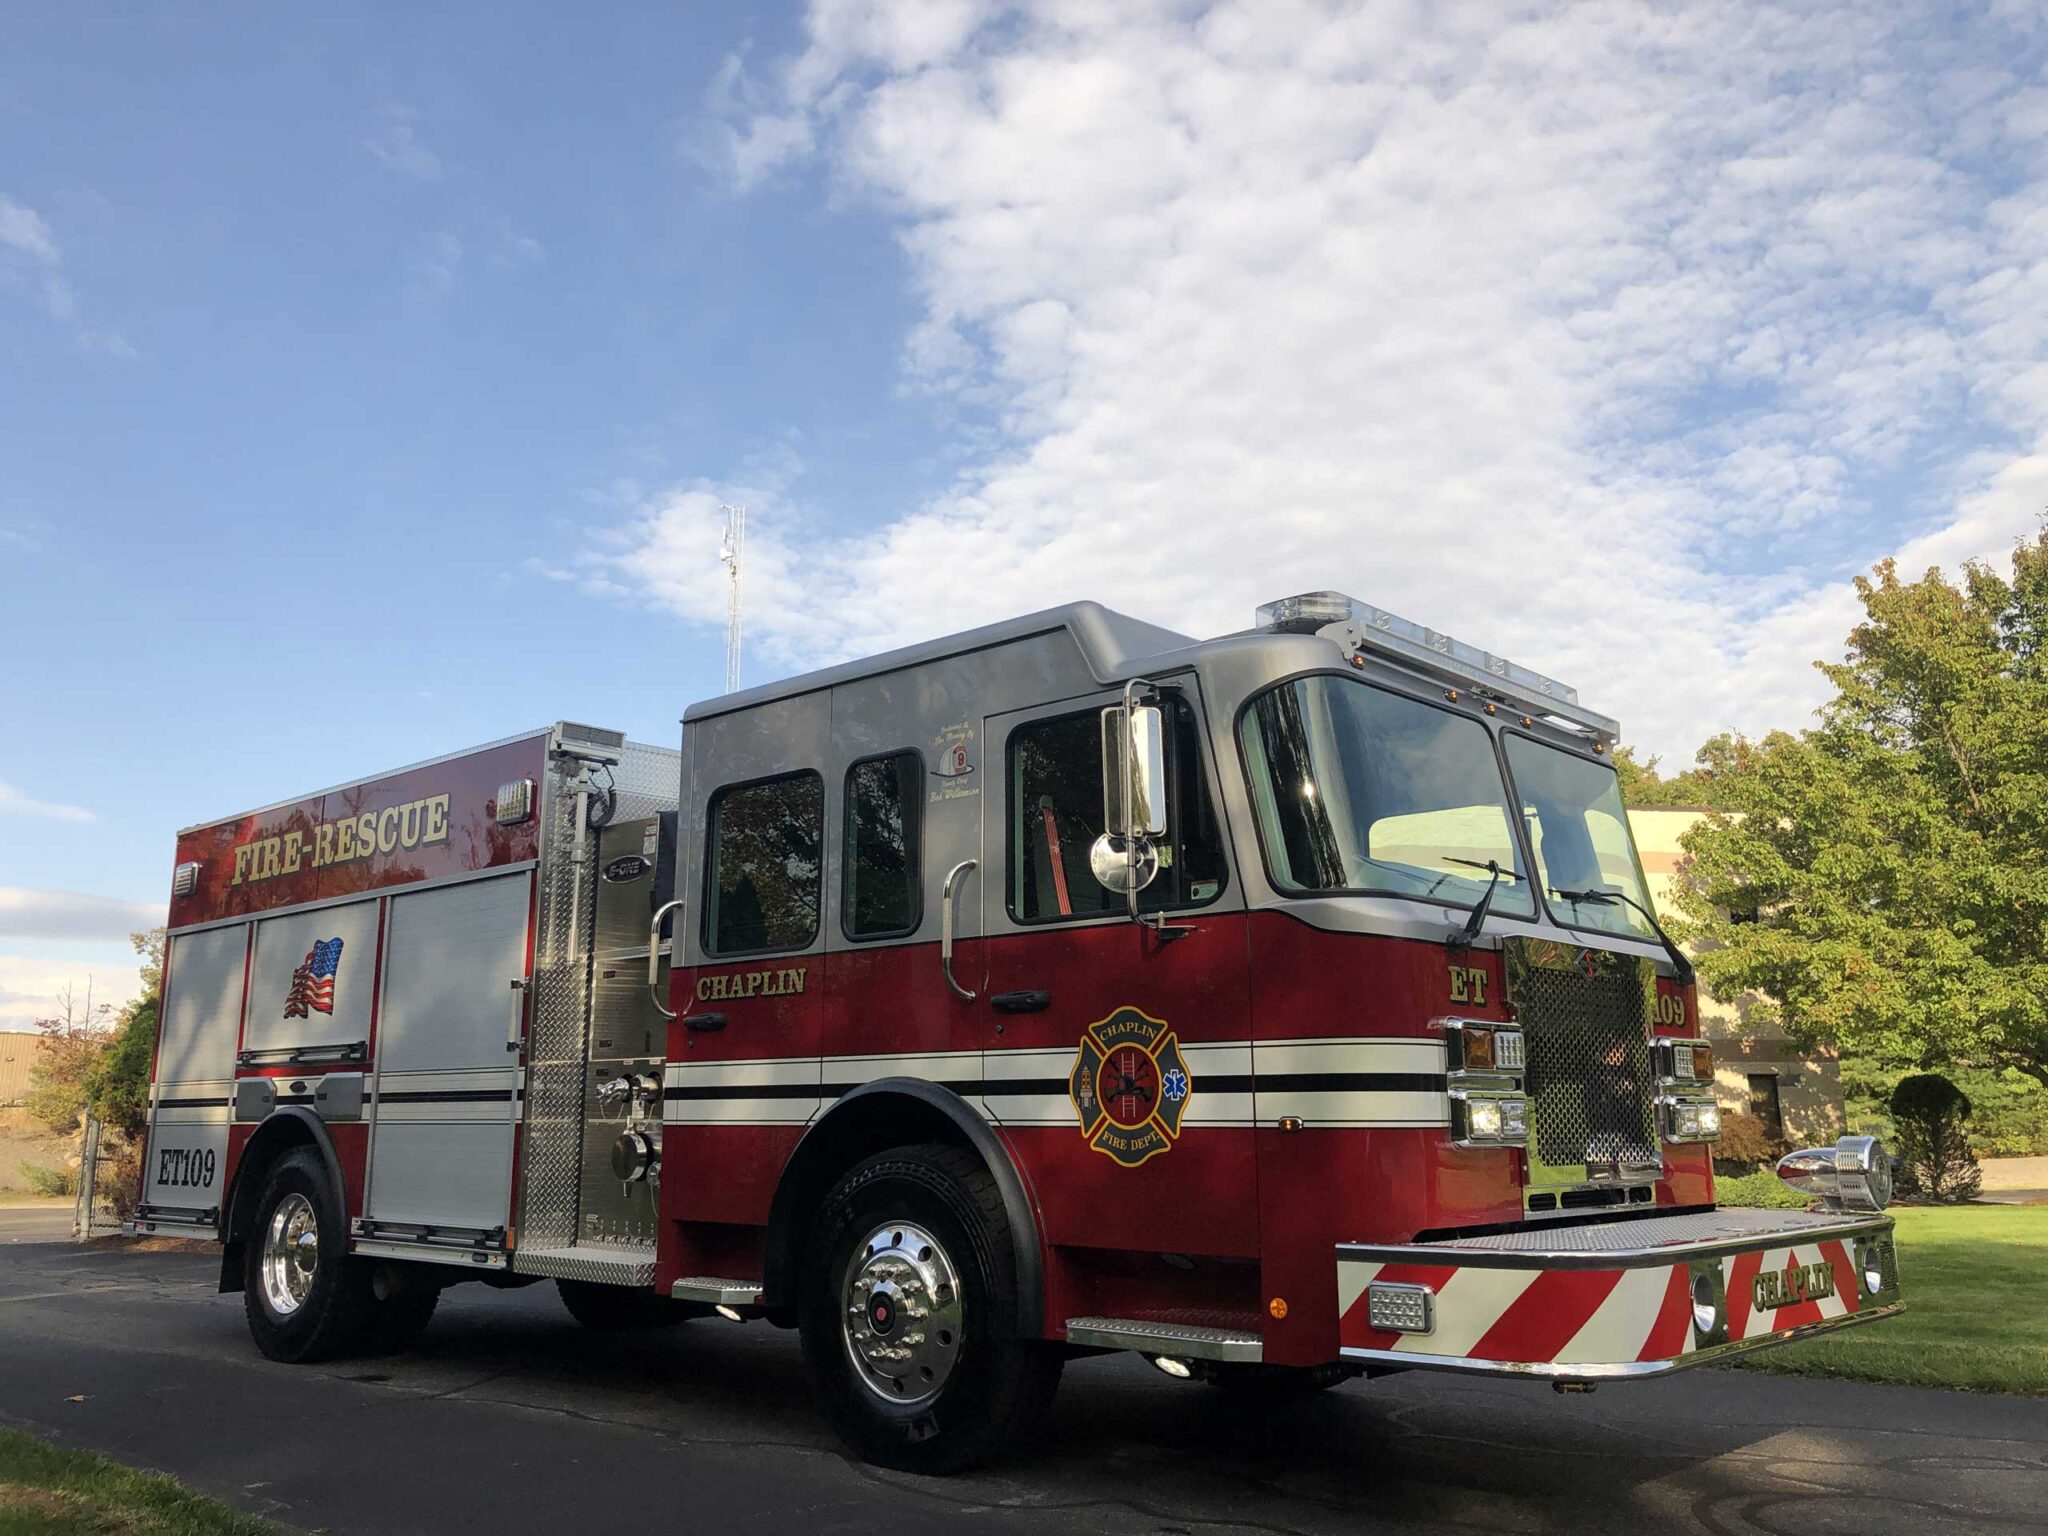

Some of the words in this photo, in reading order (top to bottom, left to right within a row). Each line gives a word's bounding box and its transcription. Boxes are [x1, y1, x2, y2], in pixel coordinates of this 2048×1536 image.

[231, 793, 450, 886] FIRE-RESCUE
[696, 968, 807, 1001] CHAPLIN
[1447, 965, 1488, 1004] ET
[1100, 1021, 1158, 1041] CHAPLIN
[1102, 1130, 1127, 1151] FIRE
[157, 1148, 216, 1188] ET109
[1752, 1261, 1835, 1313] CHAPLIN
